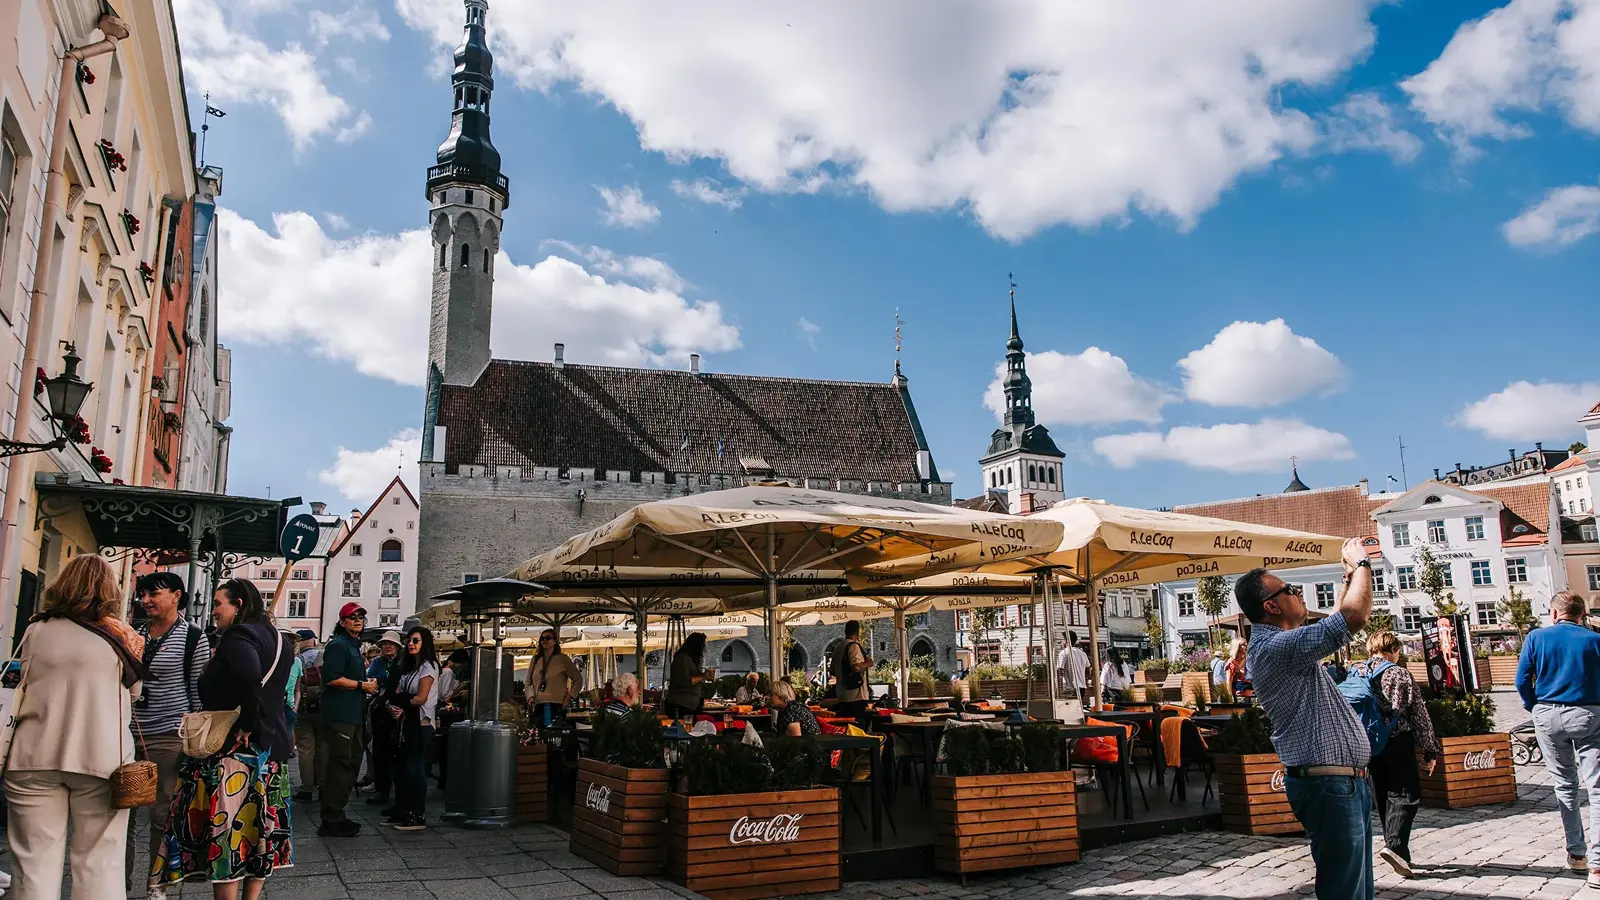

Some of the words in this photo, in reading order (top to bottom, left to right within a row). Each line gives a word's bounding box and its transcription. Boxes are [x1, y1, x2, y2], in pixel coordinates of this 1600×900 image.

[701, 512, 780, 525] A.LeCoq
[970, 522, 1026, 543] A.LeCoq
[1130, 531, 1174, 550] A.LeCoq
[290, 535, 304, 555] 1
[1213, 535, 1253, 552] A.LeCoq
[1285, 540, 1323, 555] A.LeCoq
[729, 812, 805, 847] Coca-Cola
